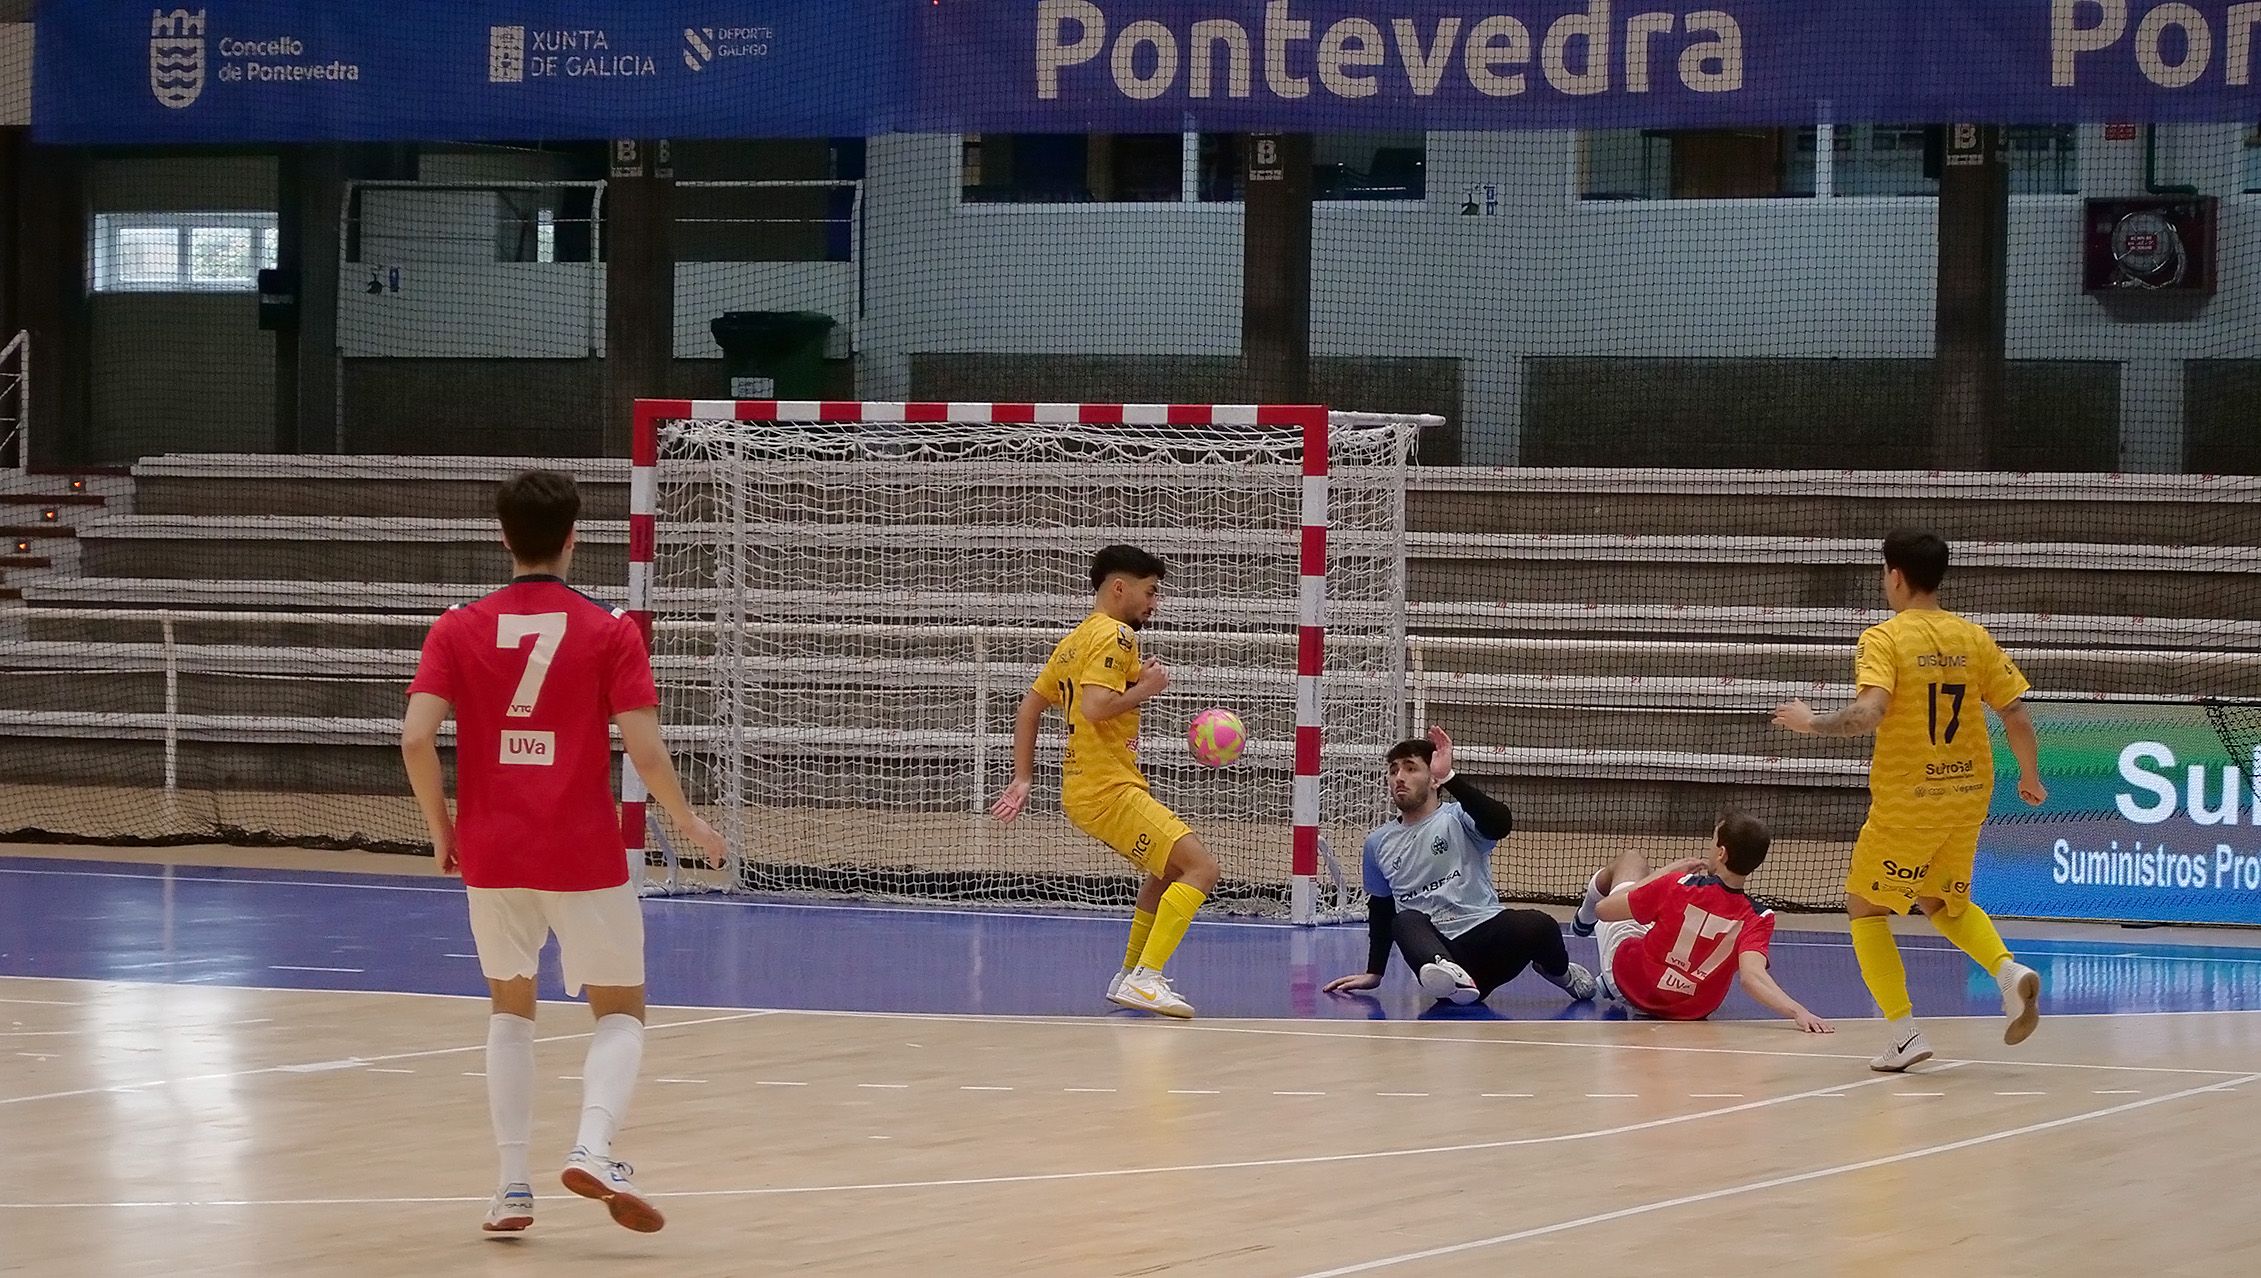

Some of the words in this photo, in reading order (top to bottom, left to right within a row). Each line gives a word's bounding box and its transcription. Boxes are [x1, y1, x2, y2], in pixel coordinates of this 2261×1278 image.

[532, 30, 608, 50] XUNTA
[718, 27, 773, 40] DEPORTE
[219, 36, 303, 56] Concello
[718, 43, 768, 57] GALEGO
[1036, 0, 1744, 98] Pontevedra
[218, 61, 242, 82] de
[247, 60, 360, 81] Pontevedra
[531, 57, 558, 77] DE
[566, 55, 656, 76] GALICIA
[617, 138, 637, 161] B
[1257, 140, 1277, 165] B
[496, 611, 568, 717] 7
[511, 704, 532, 713] VTG
[1928, 682, 1966, 746] 17
[509, 738, 546, 754] UVa
[2053, 838, 2207, 888] Suministros
[1665, 903, 1744, 981] 17
